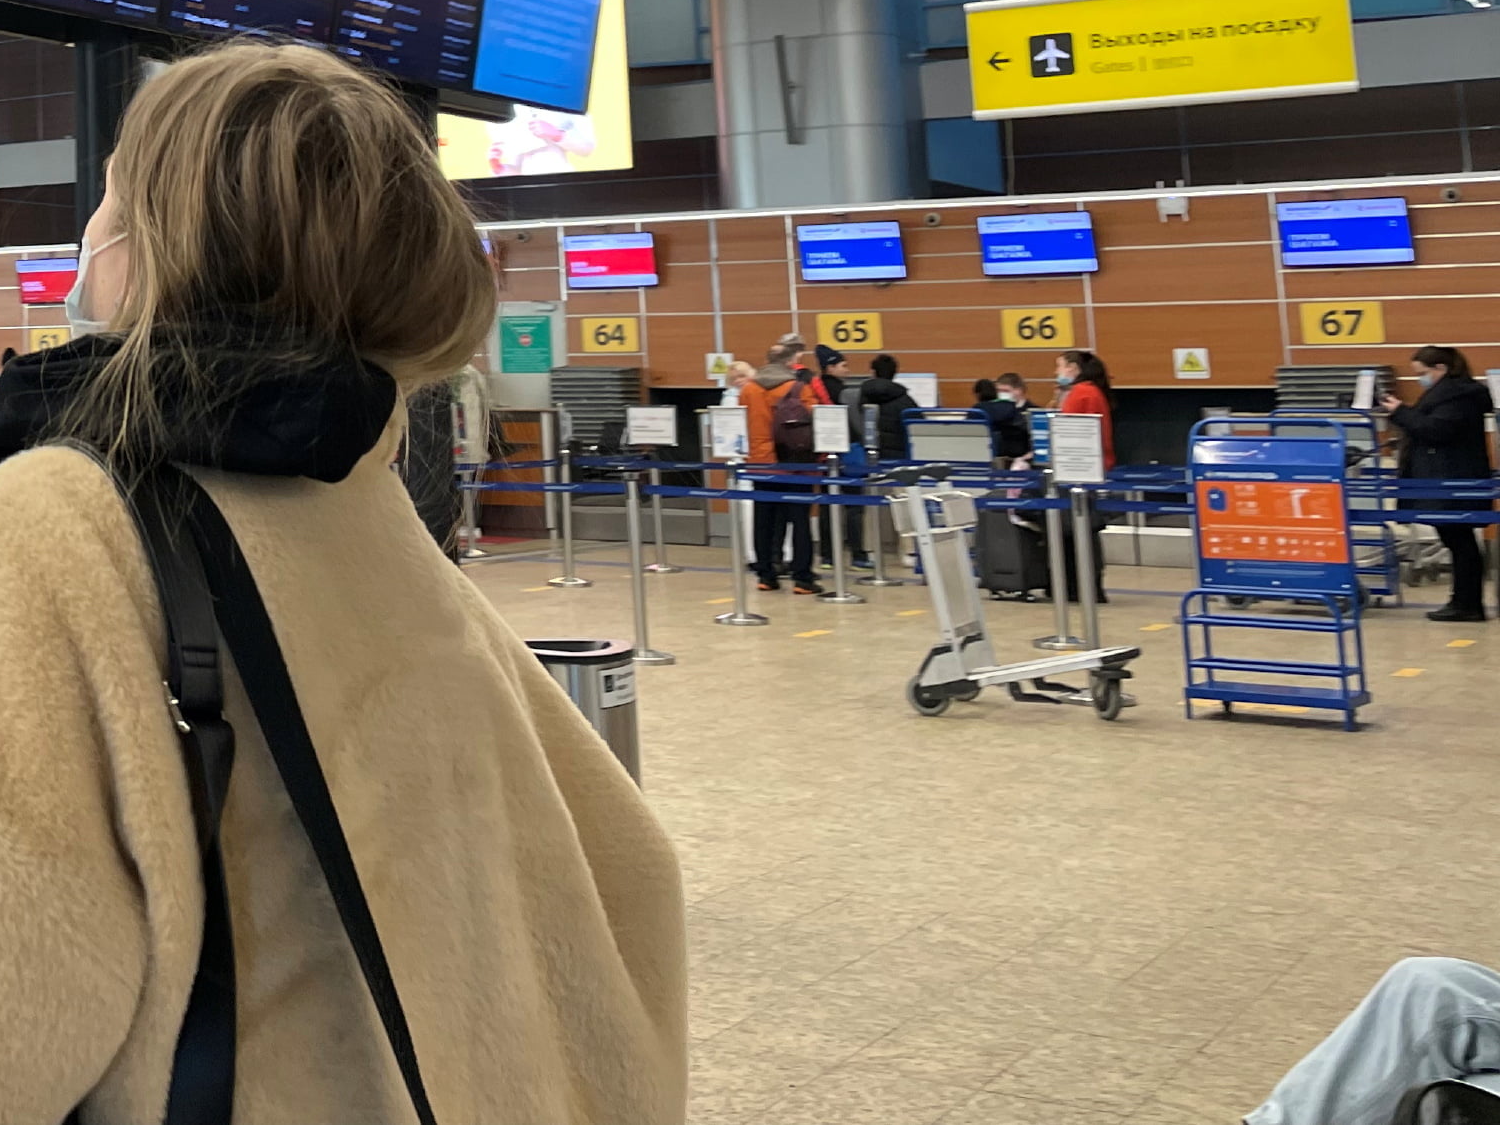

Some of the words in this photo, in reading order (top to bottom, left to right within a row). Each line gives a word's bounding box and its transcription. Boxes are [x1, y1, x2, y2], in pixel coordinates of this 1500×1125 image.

[1090, 31, 1185, 49] Выходы
[1188, 26, 1217, 41] на
[1220, 16, 1321, 38] посадку
[593, 323, 625, 346] 64
[833, 319, 870, 343] 65
[1017, 316, 1057, 340] 66
[1321, 310, 1364, 337] 67
